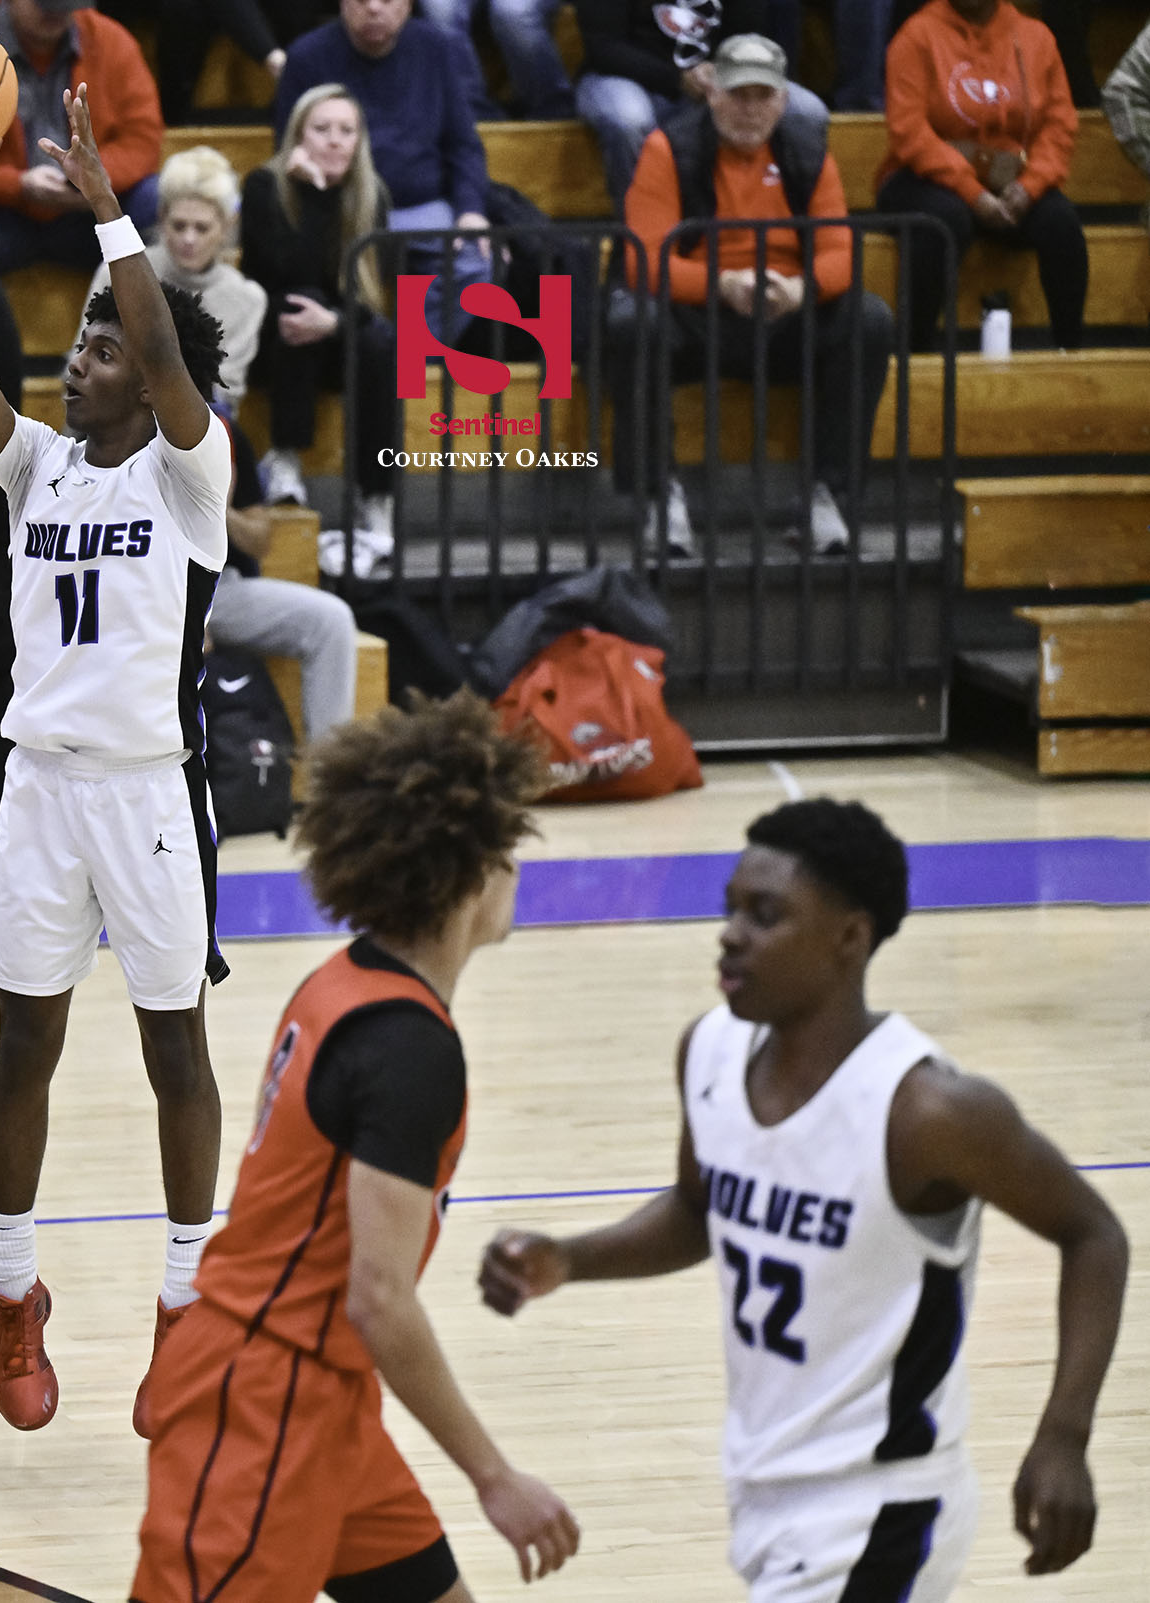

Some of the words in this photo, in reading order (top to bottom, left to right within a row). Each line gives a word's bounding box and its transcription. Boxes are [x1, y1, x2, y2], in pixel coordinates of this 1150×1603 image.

[24, 519, 154, 562] WOLVES
[55, 569, 100, 647] 11
[721, 1237, 807, 1365] 22
